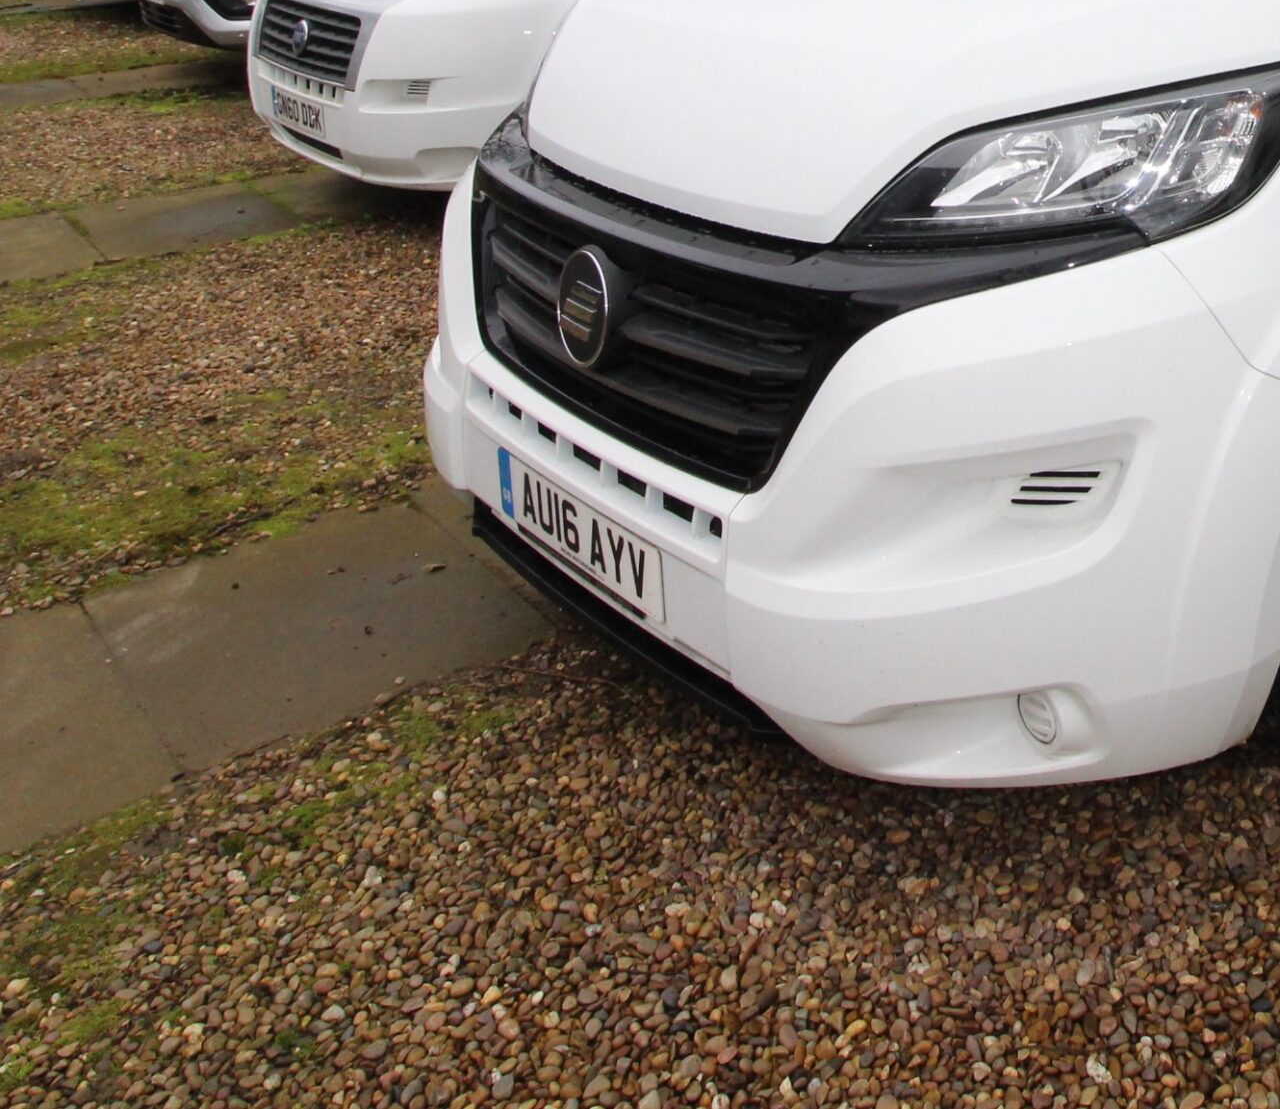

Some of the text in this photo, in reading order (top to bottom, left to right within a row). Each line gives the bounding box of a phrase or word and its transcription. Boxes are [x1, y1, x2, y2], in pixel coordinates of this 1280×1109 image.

[276, 92, 322, 132] GN60 DDK
[523, 472, 580, 554] AU16
[590, 518, 645, 600] AYV
